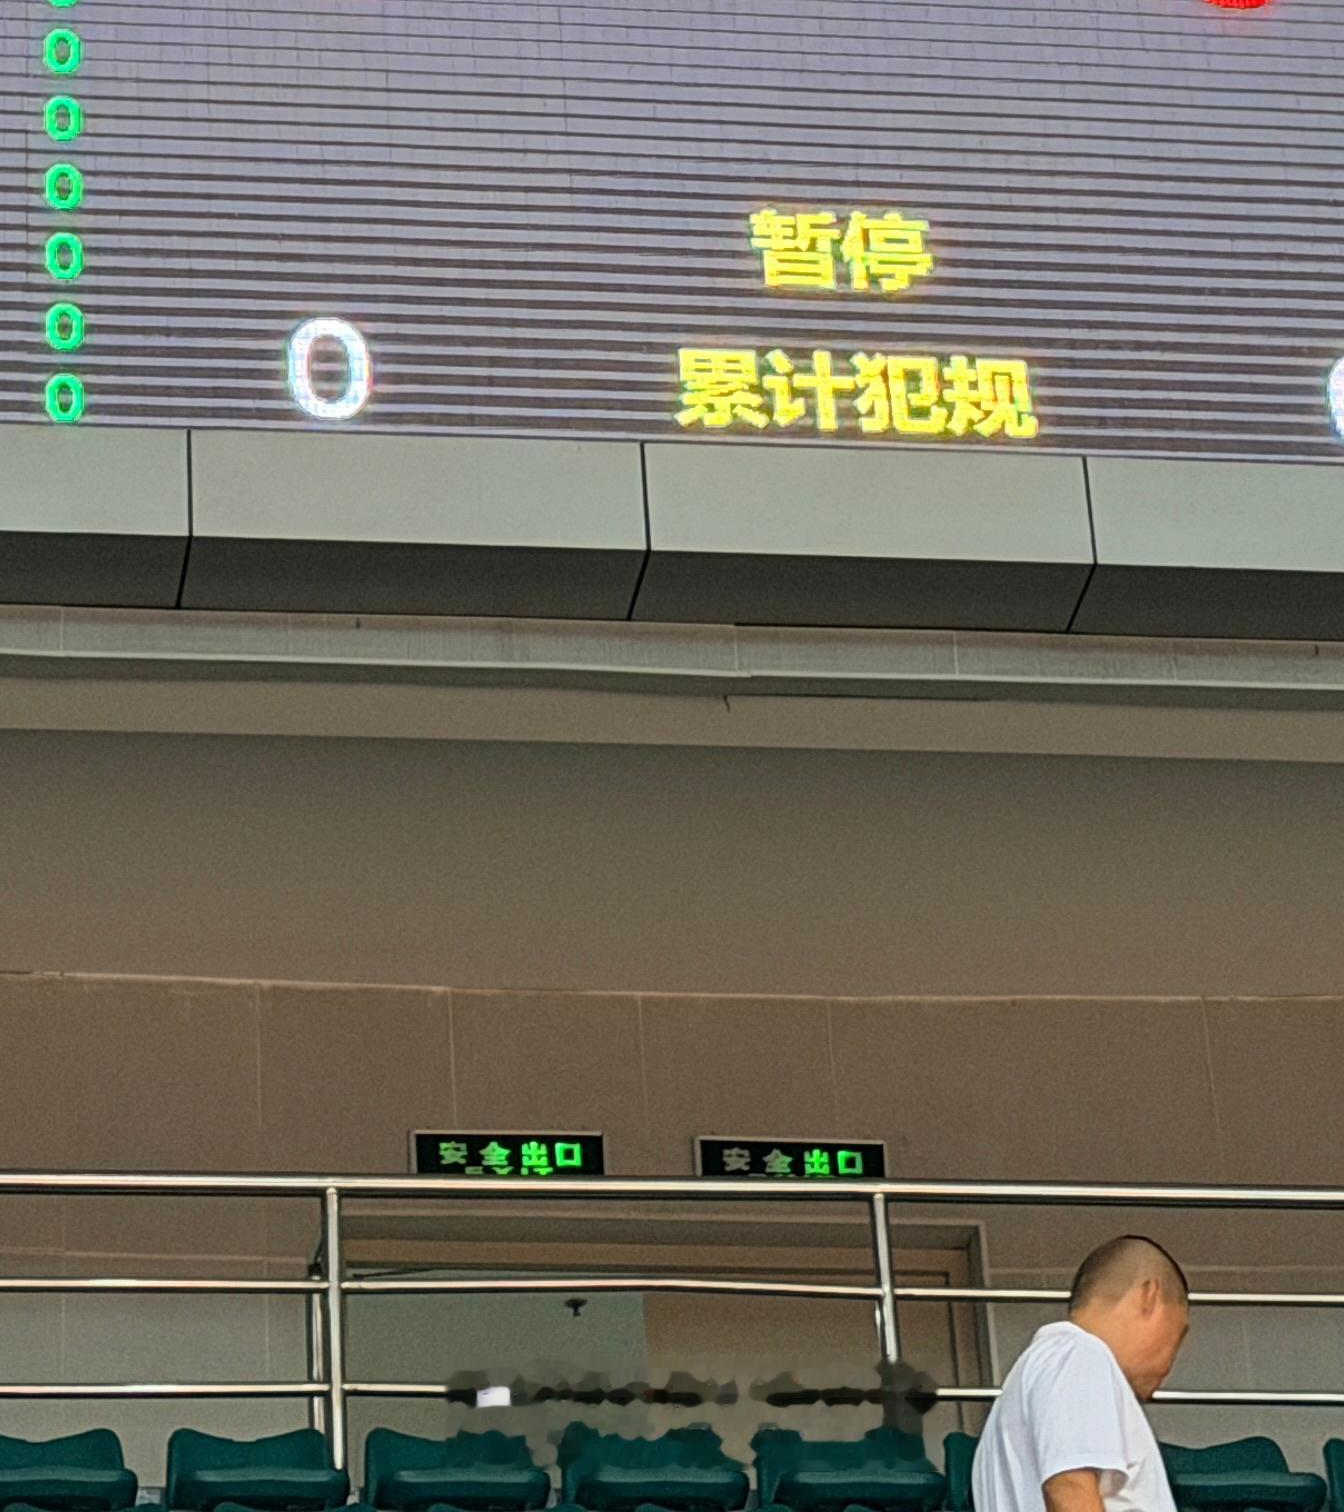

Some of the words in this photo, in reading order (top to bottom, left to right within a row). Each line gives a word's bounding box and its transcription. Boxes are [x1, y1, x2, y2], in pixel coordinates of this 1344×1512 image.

[41, 27, 85, 78] 0
[42, 94, 86, 145] 0
[43, 161, 86, 210] 0
[43, 231, 86, 282] 0
[749, 208, 935, 294] 暂停
[43, 301, 87, 353] 0
[291, 317, 370, 419] 0
[675, 348, 1039, 438] 累计犯规
[43, 372, 88, 424] 0
[438, 1140, 583, 1169] 安全出口
[721, 1147, 864, 1176] 安全出口
